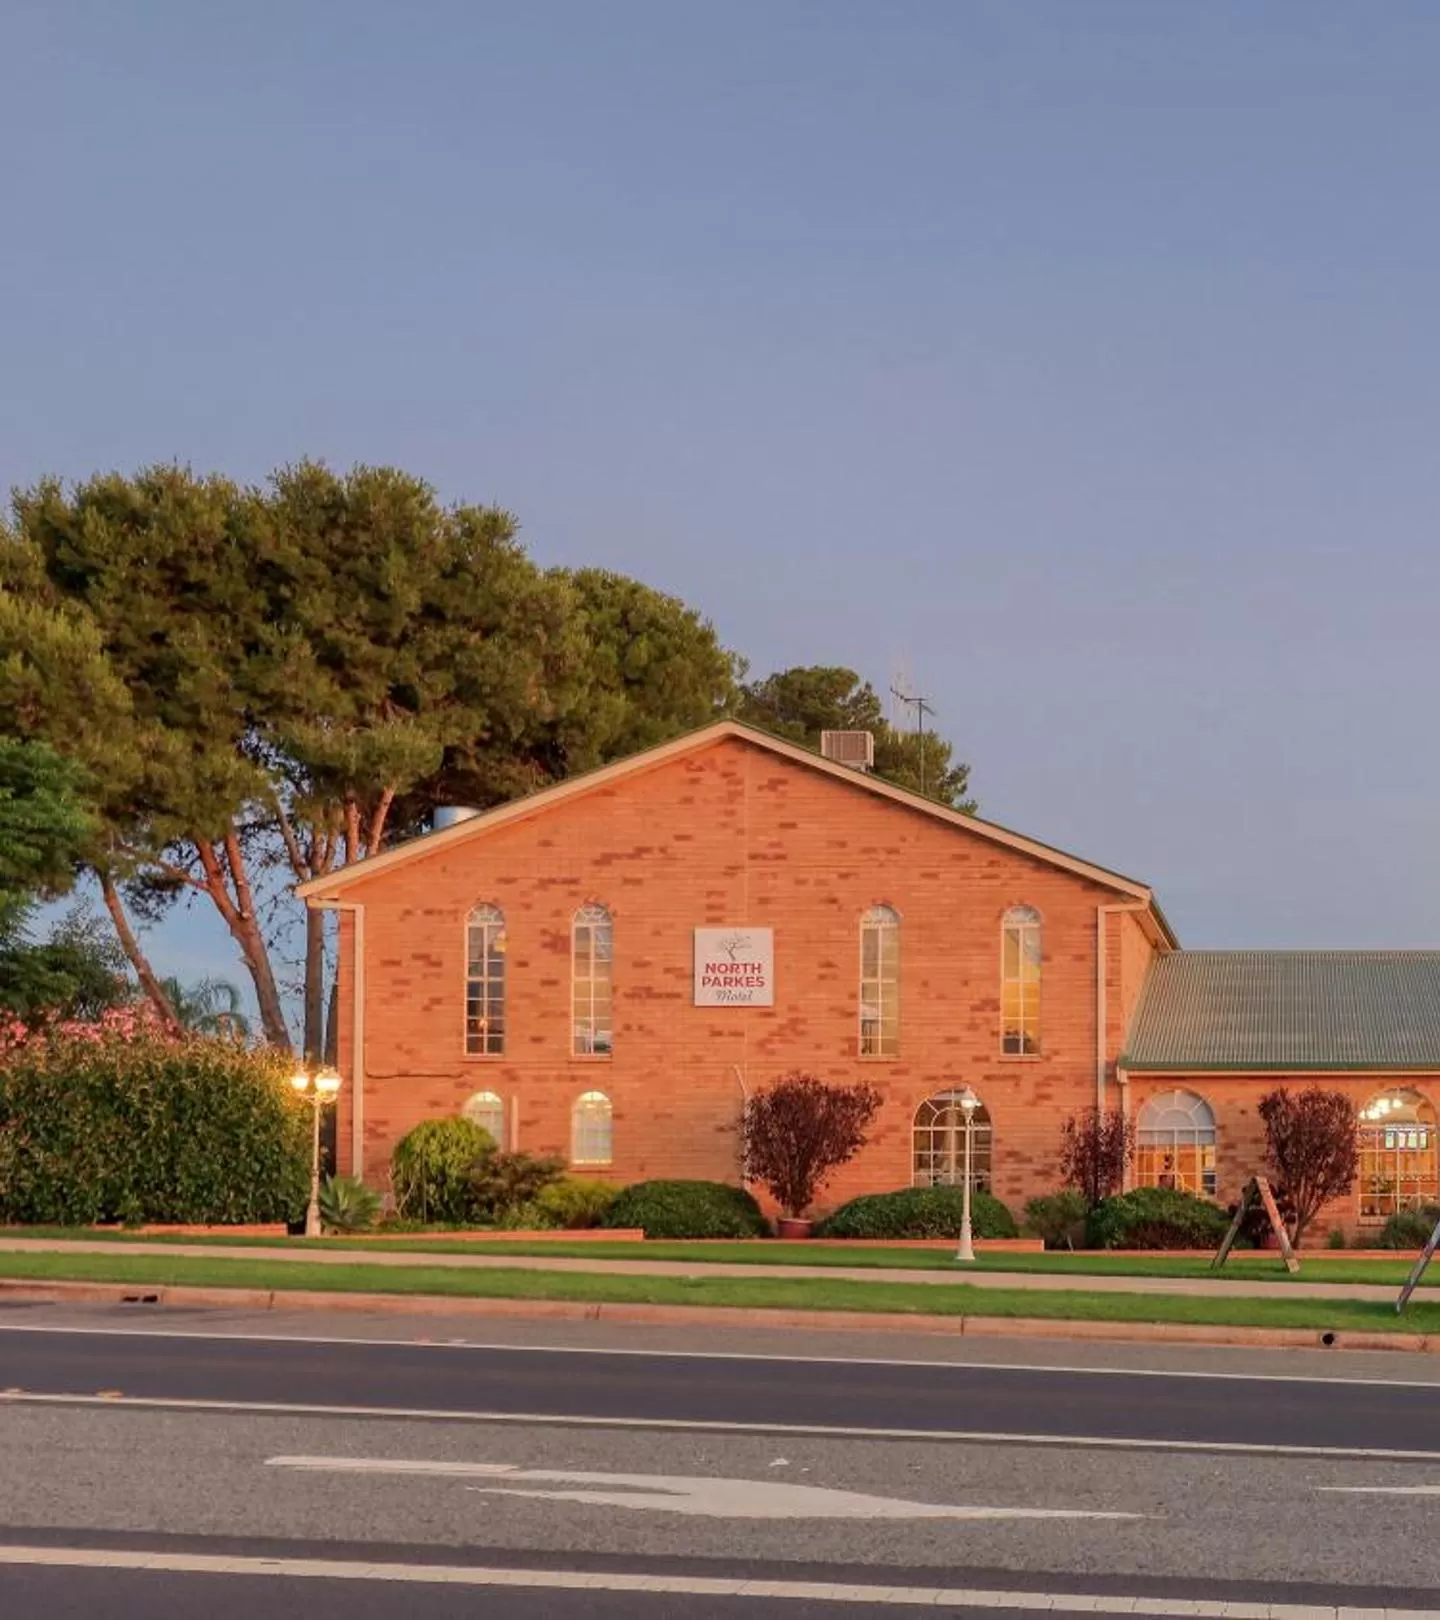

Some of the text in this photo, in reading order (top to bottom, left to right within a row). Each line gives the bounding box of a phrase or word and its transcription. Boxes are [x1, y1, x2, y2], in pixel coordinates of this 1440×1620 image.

[705, 963, 762, 974] NORTH
[702, 976, 765, 987] PARKES
[715, 989, 753, 1001] Motel
